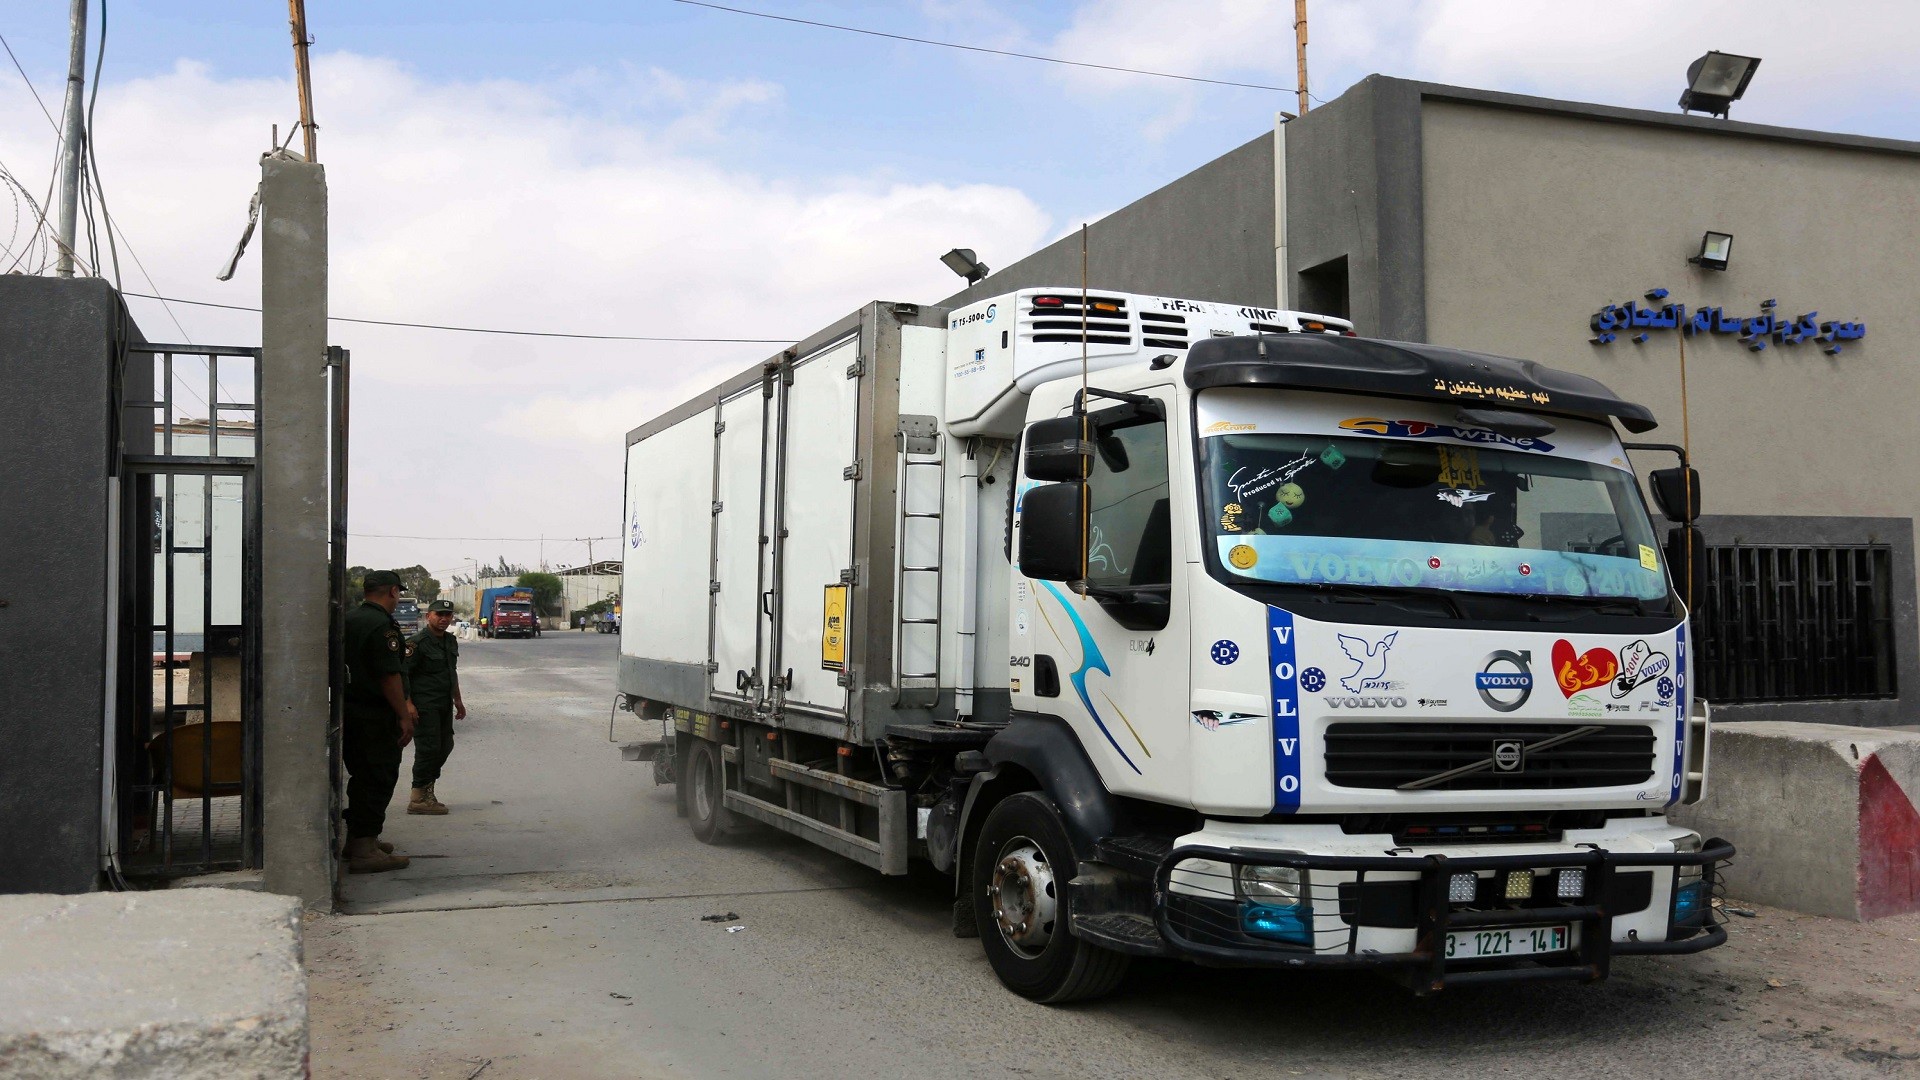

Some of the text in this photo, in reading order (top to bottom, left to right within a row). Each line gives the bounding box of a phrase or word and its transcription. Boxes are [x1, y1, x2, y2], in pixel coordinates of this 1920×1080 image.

[959, 312, 985, 327] TS-500e
[1817, 320, 1865, 355] معبر
[1452, 428, 1534, 446] WING
[1242, 480, 1275, 498] Produced
[1287, 552, 1422, 586] VOLVO
[1220, 647, 1230, 657] D
[1010, 655, 1030, 668] 240
[1625, 651, 1640, 675] 2010
[1640, 658, 1668, 678] VOLVO
[1308, 675, 1318, 685] D
[1480, 676, 1529, 686] VOLVO
[1272, 626, 1299, 793] VOLVO
[1323, 696, 1407, 709] VOLVO
